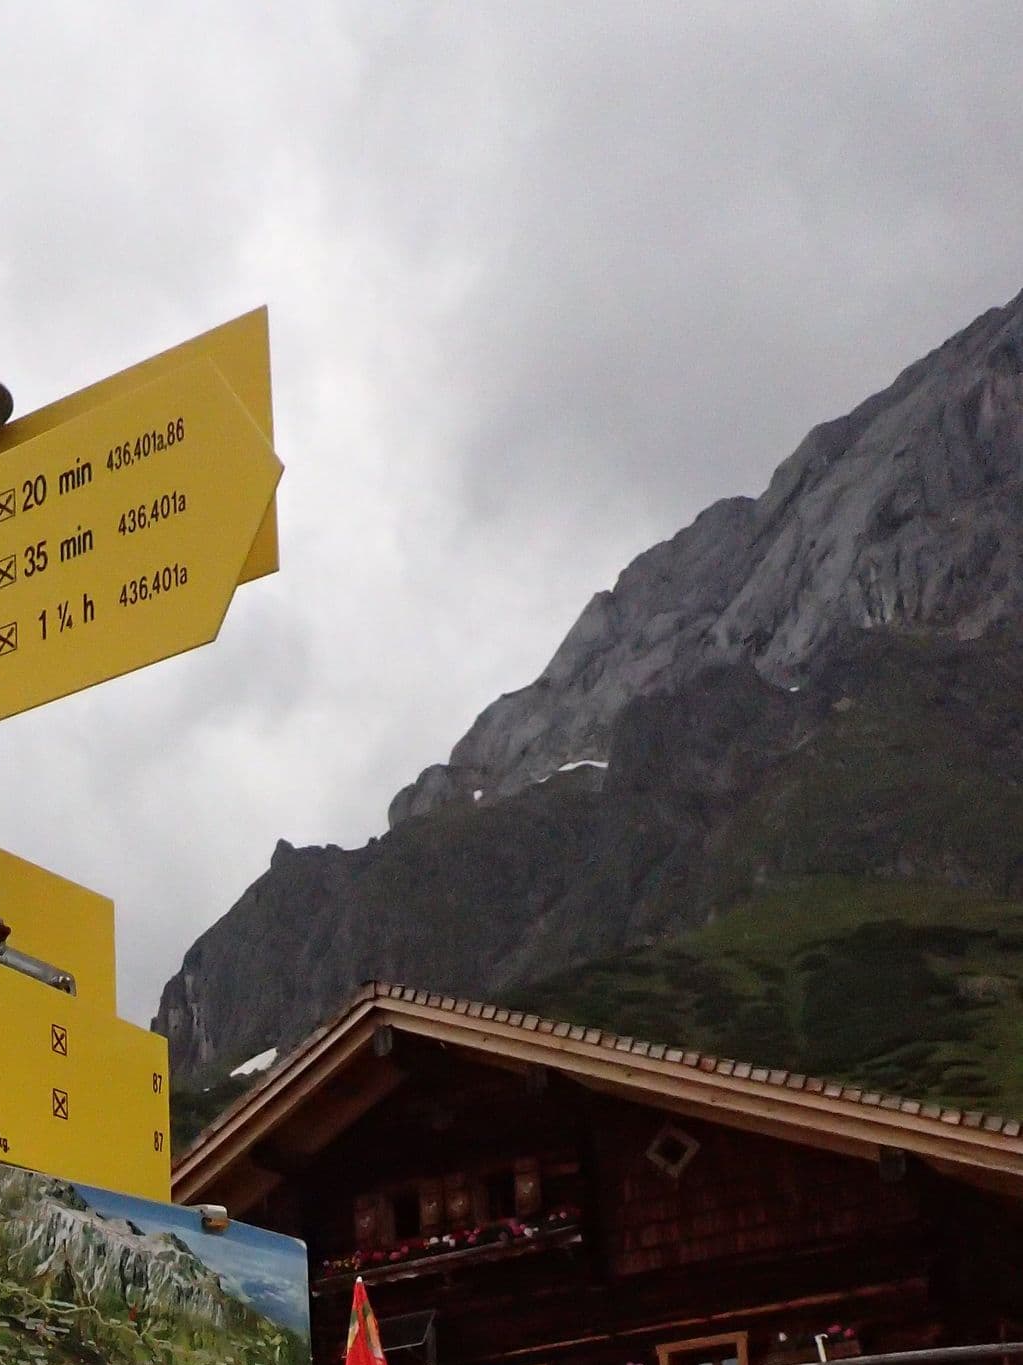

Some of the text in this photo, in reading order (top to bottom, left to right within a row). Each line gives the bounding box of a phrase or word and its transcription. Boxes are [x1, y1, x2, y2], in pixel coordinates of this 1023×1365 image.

[22, 474, 47, 512] 20
[59, 457, 92, 496] min
[106, 417, 185, 472] 436,401a,86
[24, 540, 48, 577] 35
[60, 525, 93, 562] min
[118, 490, 186, 536] 436,401a
[38, 609, 47, 640] 1
[83, 592, 95, 624] h
[119, 562, 188, 607] 436,401a
[152, 1072, 163, 1094] 87
[154, 1130, 164, 1153] 87
